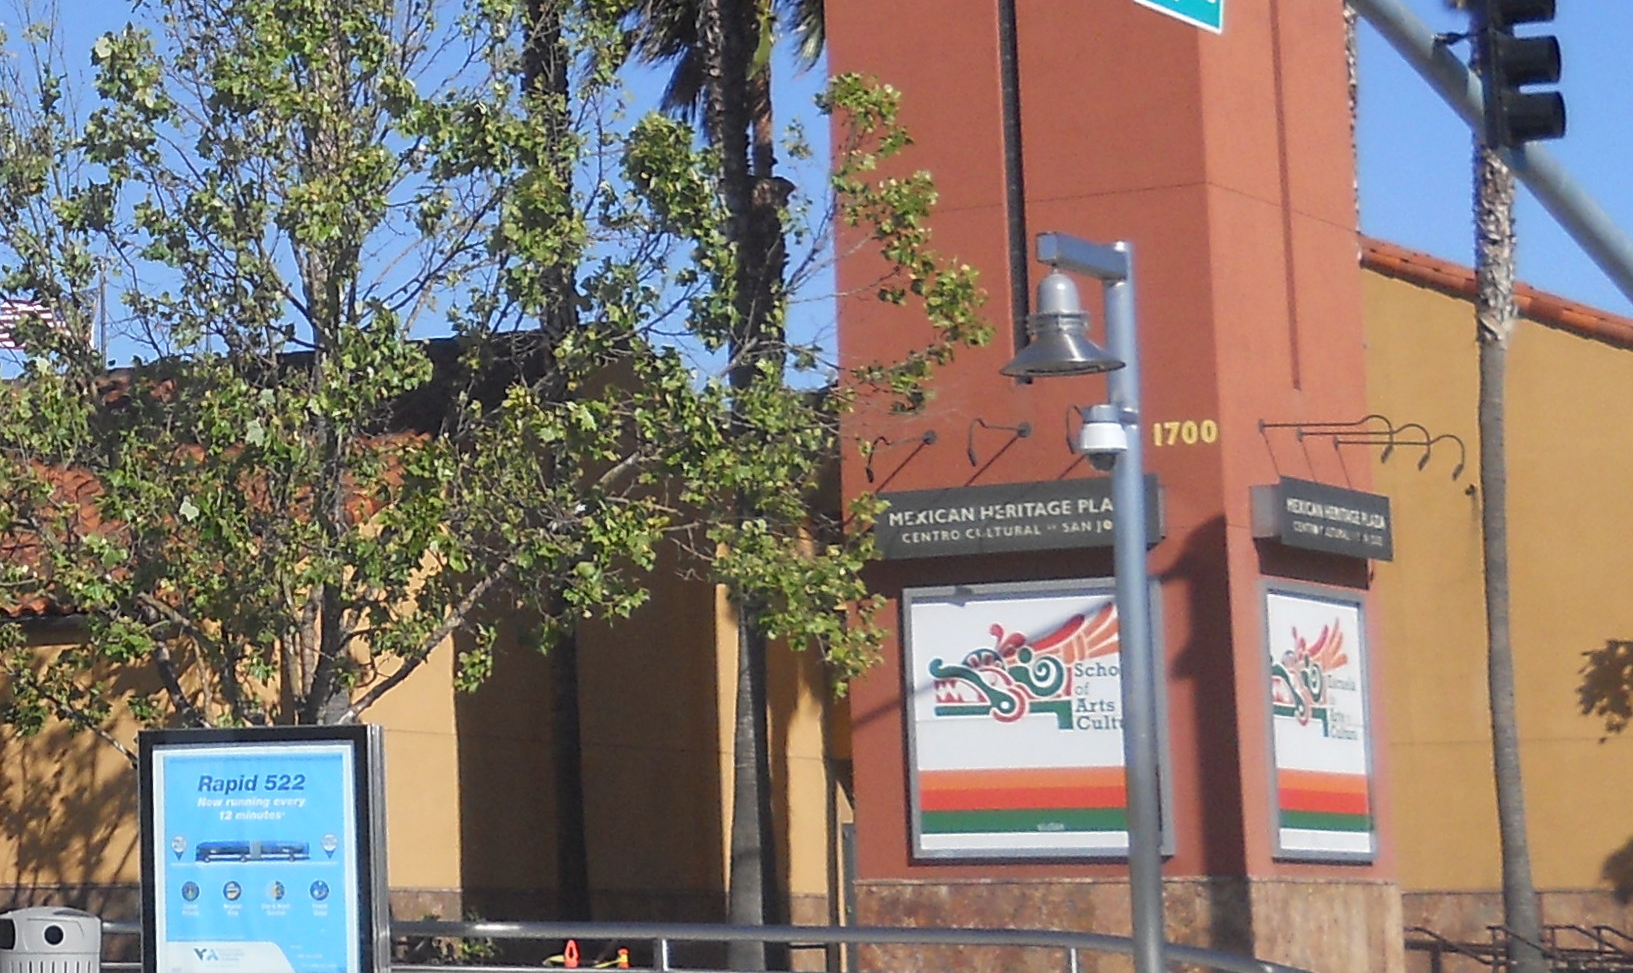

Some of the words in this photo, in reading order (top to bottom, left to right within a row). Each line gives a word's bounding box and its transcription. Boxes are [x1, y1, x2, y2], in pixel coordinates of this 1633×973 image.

[1153, 419, 1218, 446] 1700
[889, 507, 975, 527] MEXICAN
[980, 500, 1072, 520] HERITAGE
[1078, 497, 1114, 514] PLA
[901, 530, 960, 544] CENTRO
[1062, 521, 1092, 534] SAN
[1096, 519, 1114, 534] JO
[1074, 662, 1120, 678] Scho
[1074, 682, 1089, 696] of
[1075, 698, 1115, 713] Arts
[1076, 715, 1122, 731] Cult
[197, 774, 259, 795] Rapid
[264, 774, 306, 791] 522
[197, 797, 224, 807] Now
[225, 796, 271, 808] running
[272, 797, 306, 808] every
[219, 810, 234, 821] 12
